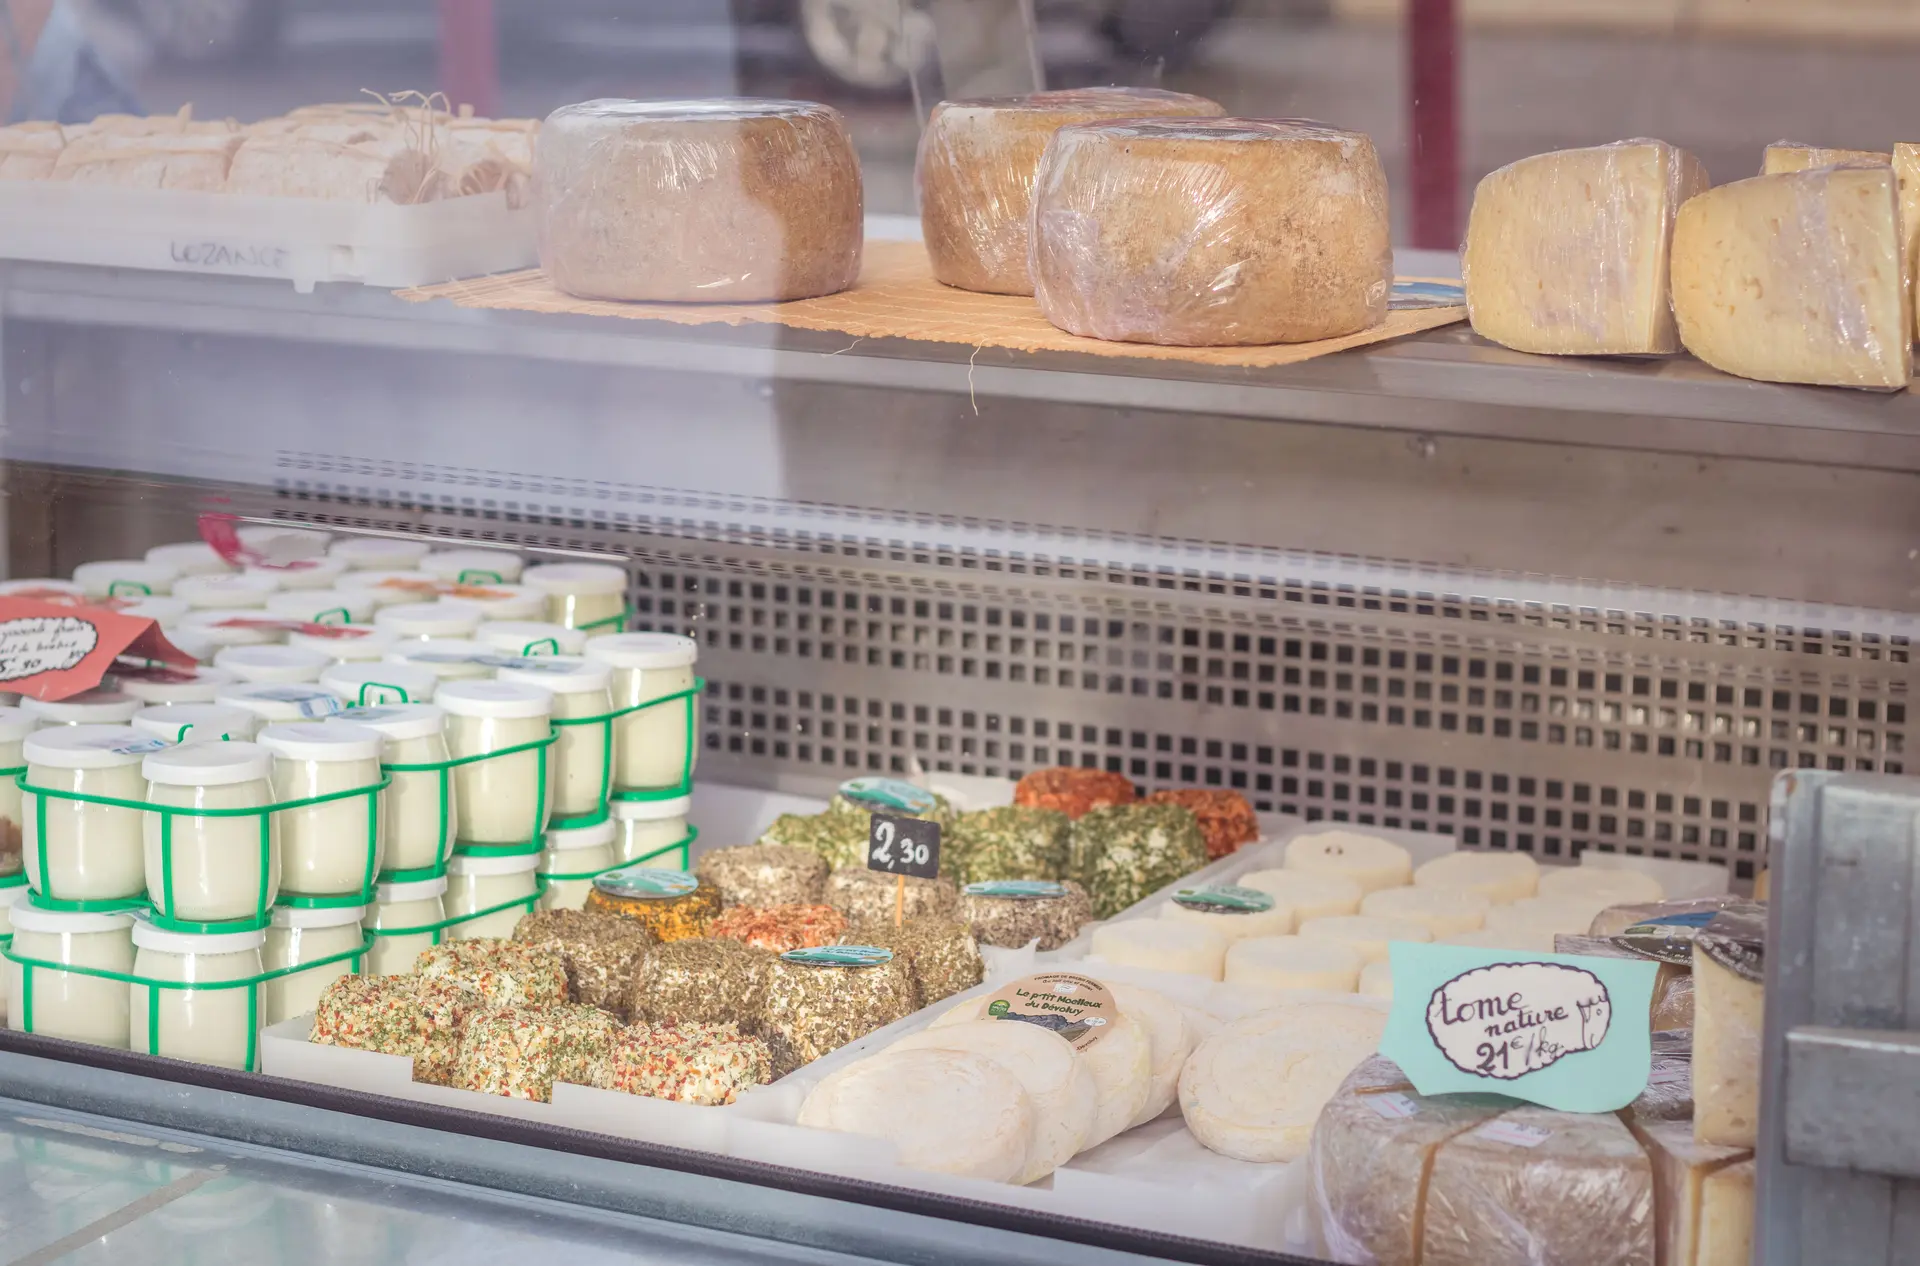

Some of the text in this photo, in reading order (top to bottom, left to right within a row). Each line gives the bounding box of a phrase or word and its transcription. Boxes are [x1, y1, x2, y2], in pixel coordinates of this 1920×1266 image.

[871, 821, 930, 870] 2,30
[1025, 1001, 1084, 1016] du Dévoluy
[1056, 995, 1103, 1009] Moelleux
[1484, 1006, 1569, 1038] nature
